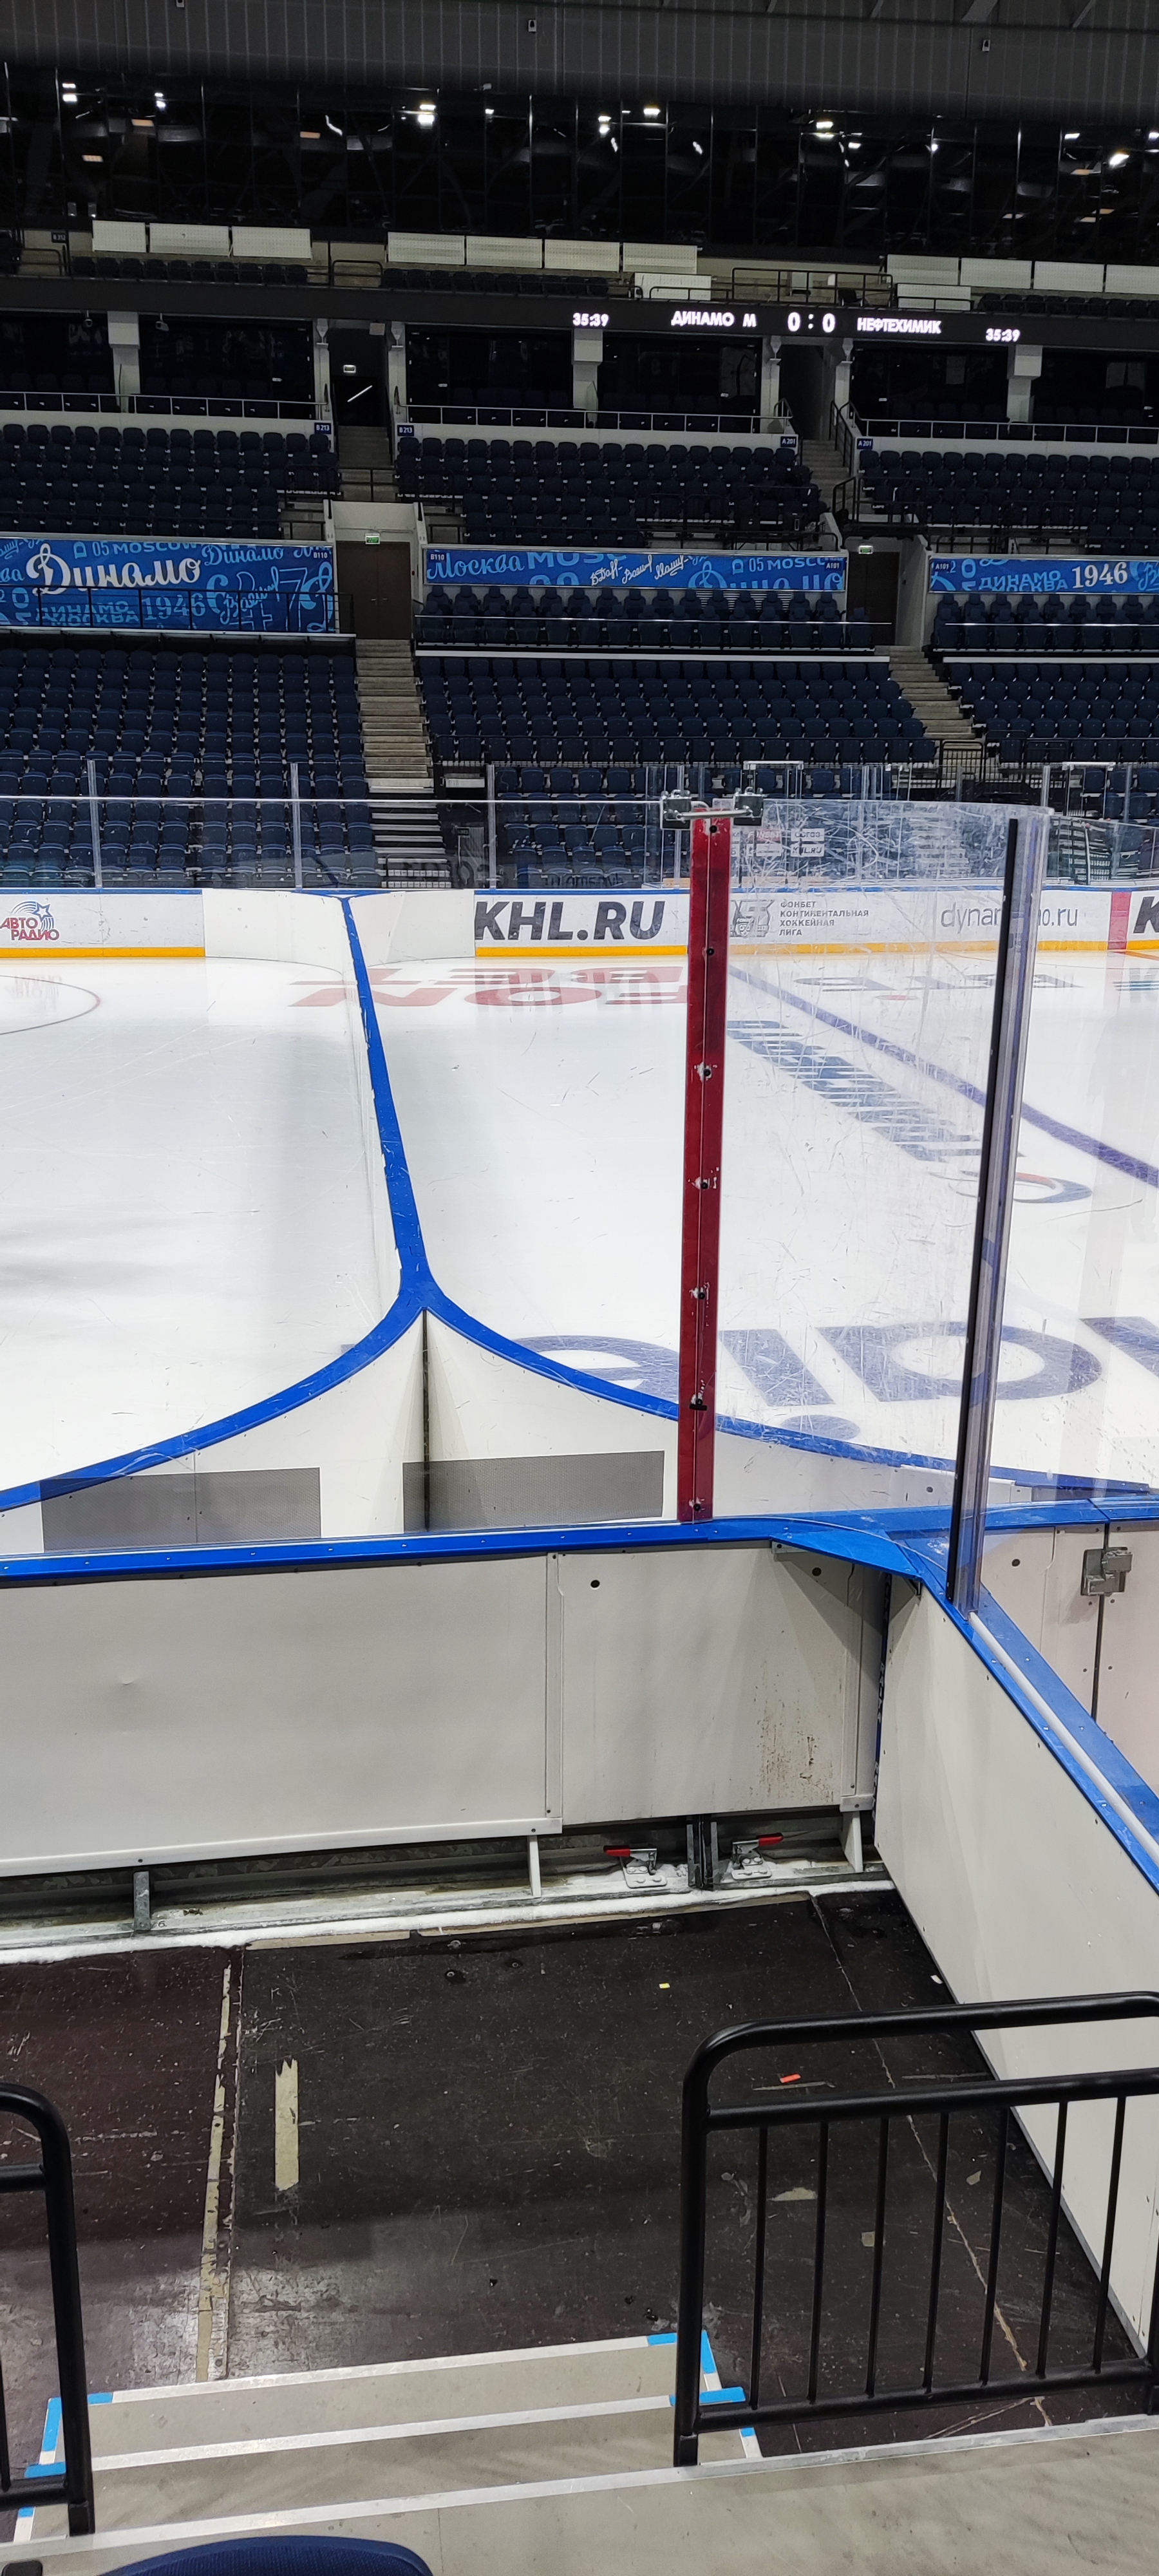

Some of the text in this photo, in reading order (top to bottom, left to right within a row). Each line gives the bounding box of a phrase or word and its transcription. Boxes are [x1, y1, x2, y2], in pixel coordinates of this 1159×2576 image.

[572, 313, 610, 327] 35:39
[671, 310, 757, 327] ДИНАМО М
[787, 312, 800, 332] 0
[822, 313, 835, 333] 0
[857, 317, 941, 334] НЕФТЕХИМИК
[986, 328, 1021, 342] 35:39
[201, 544, 285, 566] Динамо
[26, 543, 202, 594] Динамо
[427, 552, 525, 580] Москва
[1072, 562, 1128, 589] 1946
[142, 592, 205, 621] 1946
[475, 900, 666, 941] KHL.RU
[780, 909, 869, 918] КОНТИНЕНТАЛЬНАЯ
[780, 918, 835, 927] ХОККЕЙНАЯ
[11, 929, 59, 941] РАДИО
